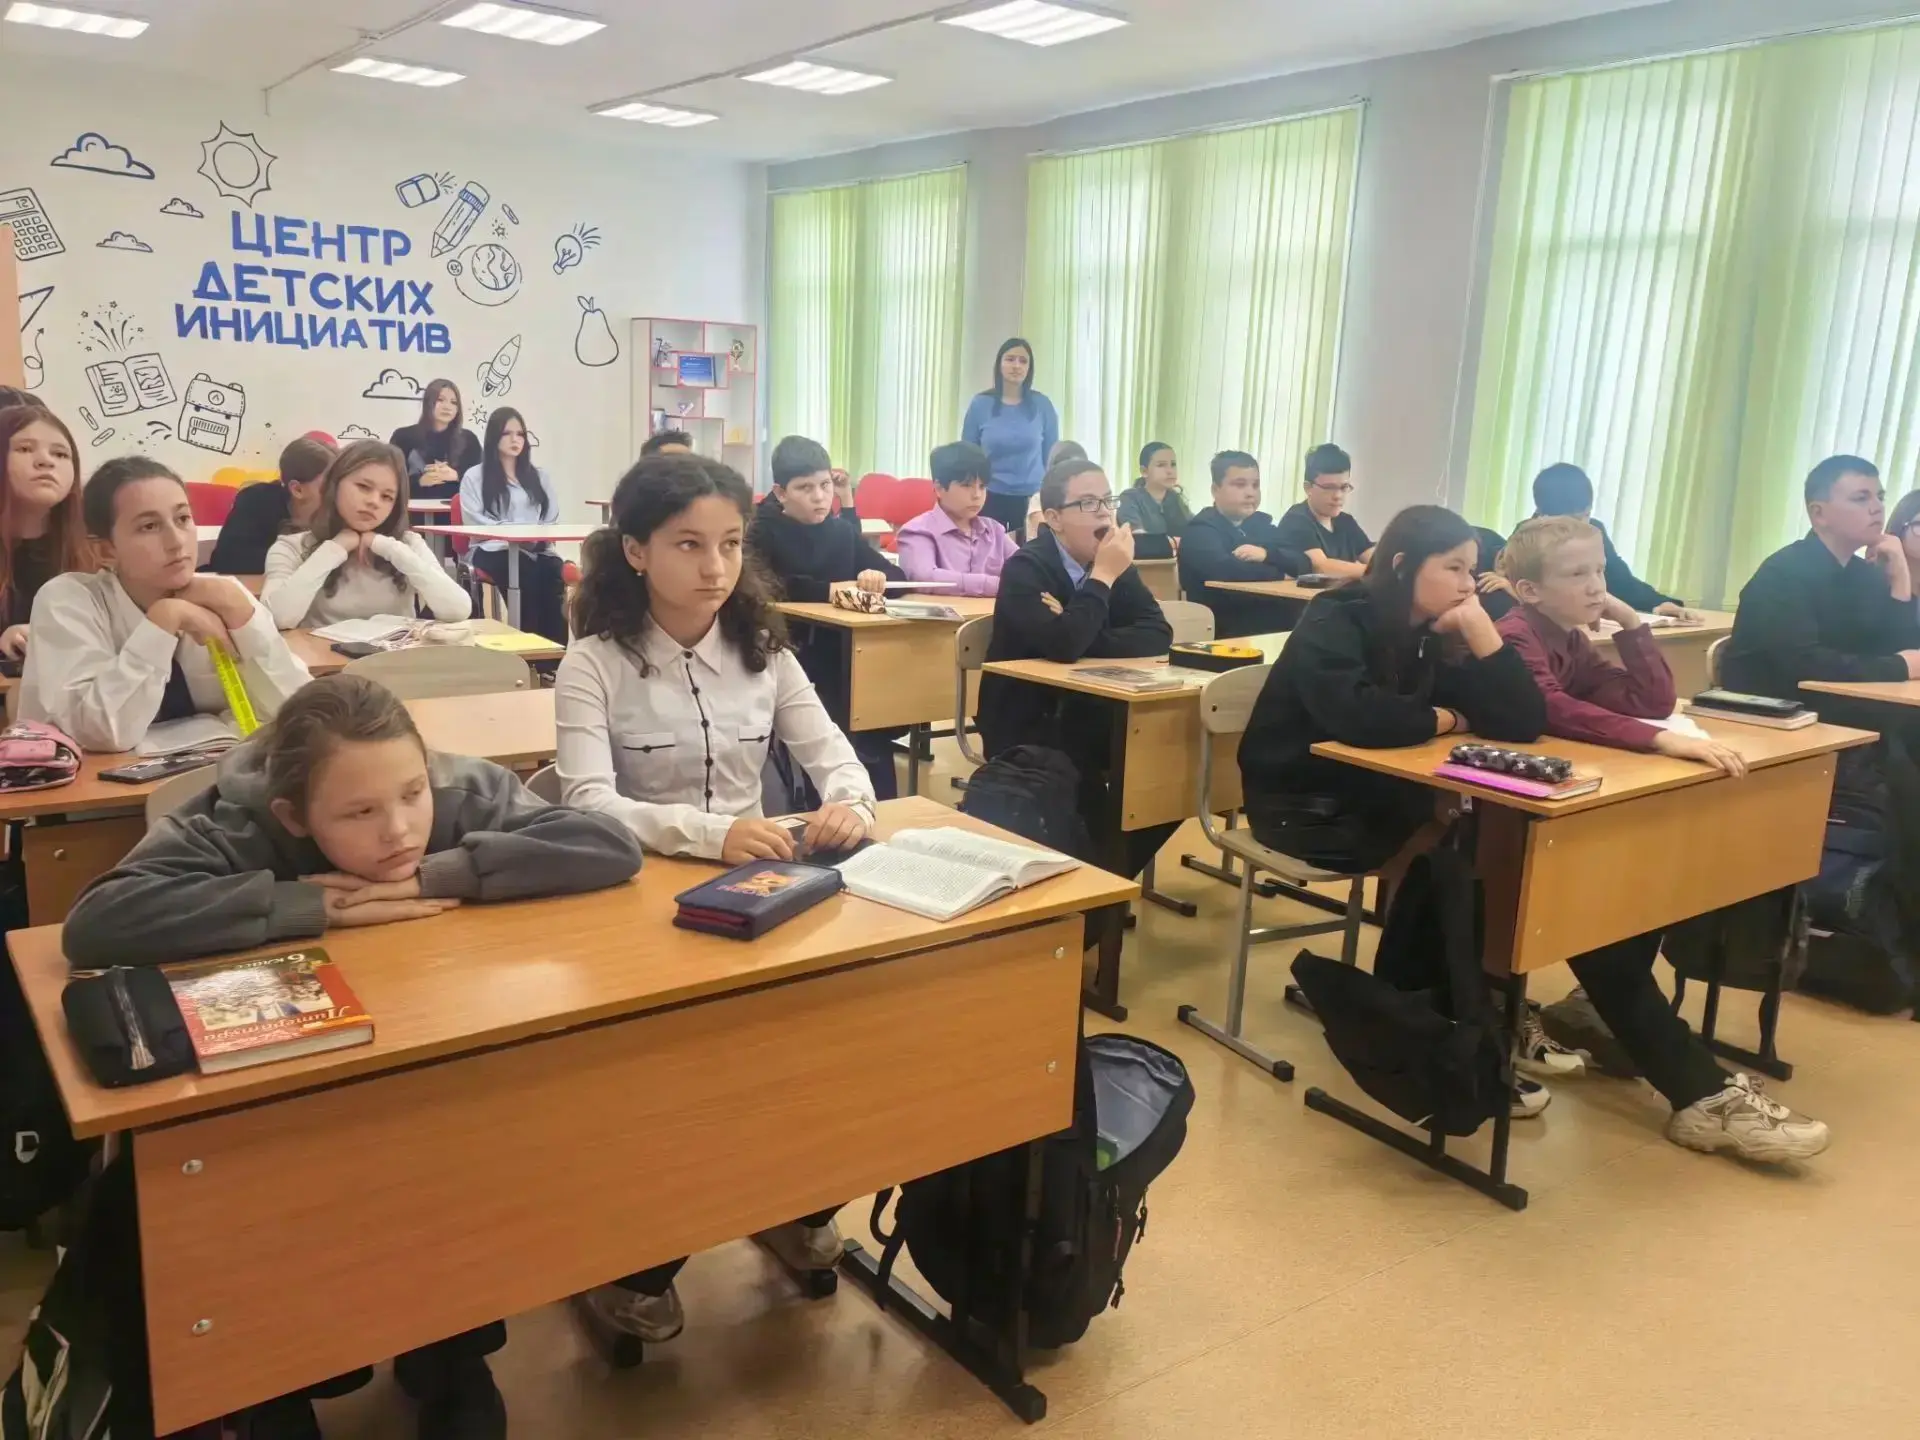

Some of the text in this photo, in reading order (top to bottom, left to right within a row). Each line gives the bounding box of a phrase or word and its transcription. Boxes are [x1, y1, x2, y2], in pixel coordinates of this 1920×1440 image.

[16, 198, 28, 209] 12
[232, 210, 412, 266] ЦЕНТР
[193, 261, 434, 316] ДЕТСКИХ
[174, 303, 452, 354] ИНИЦИАТИВ
[287, 953, 305, 964] 6
[204, 1006, 351, 1042] Литература
